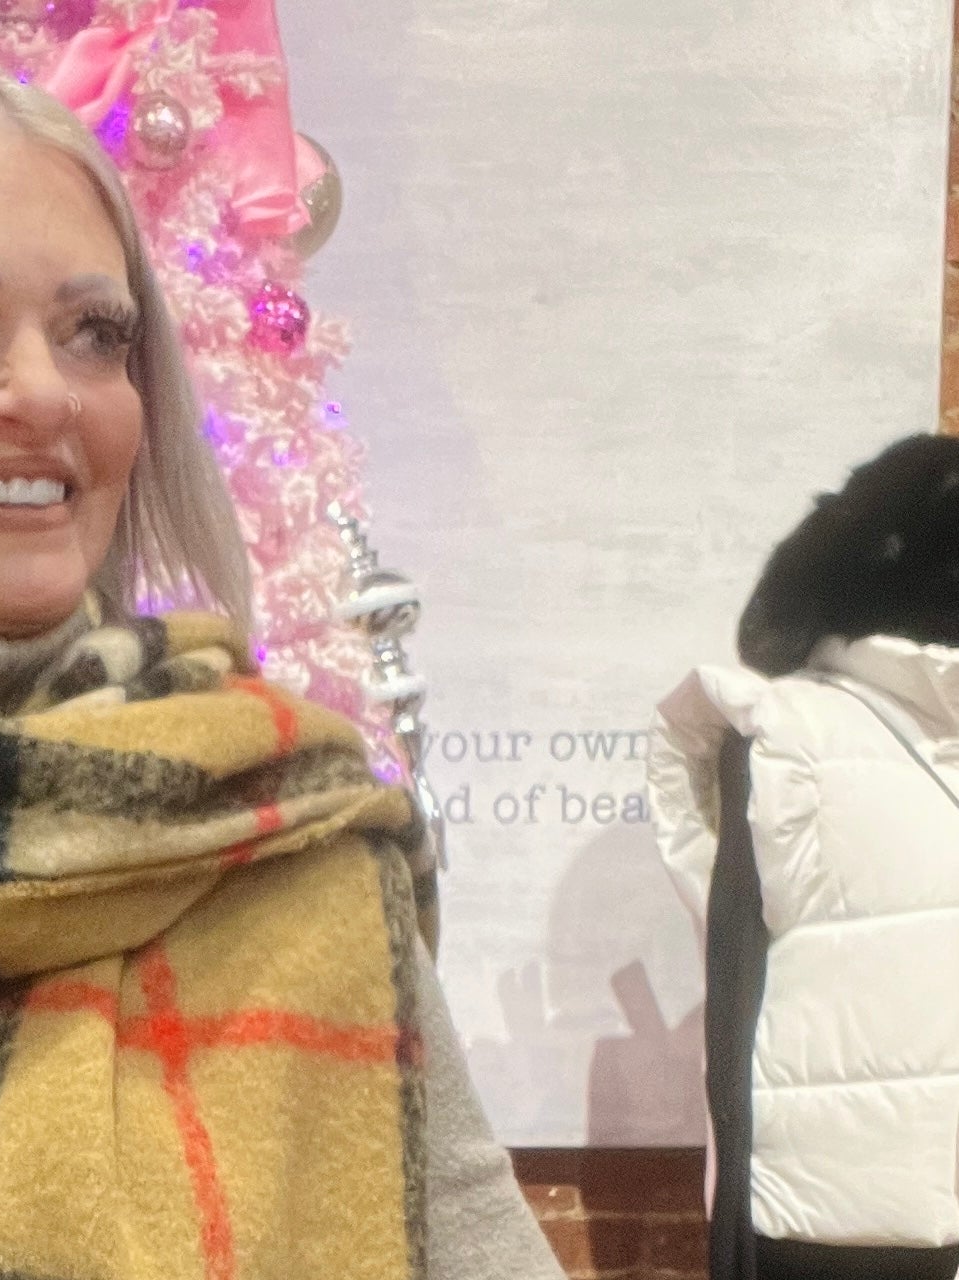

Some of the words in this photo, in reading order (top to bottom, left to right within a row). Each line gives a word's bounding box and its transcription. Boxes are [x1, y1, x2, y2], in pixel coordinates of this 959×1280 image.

[444, 783, 475, 824] d
[493, 784, 547, 824] of
[556, 784, 650, 825] bea
